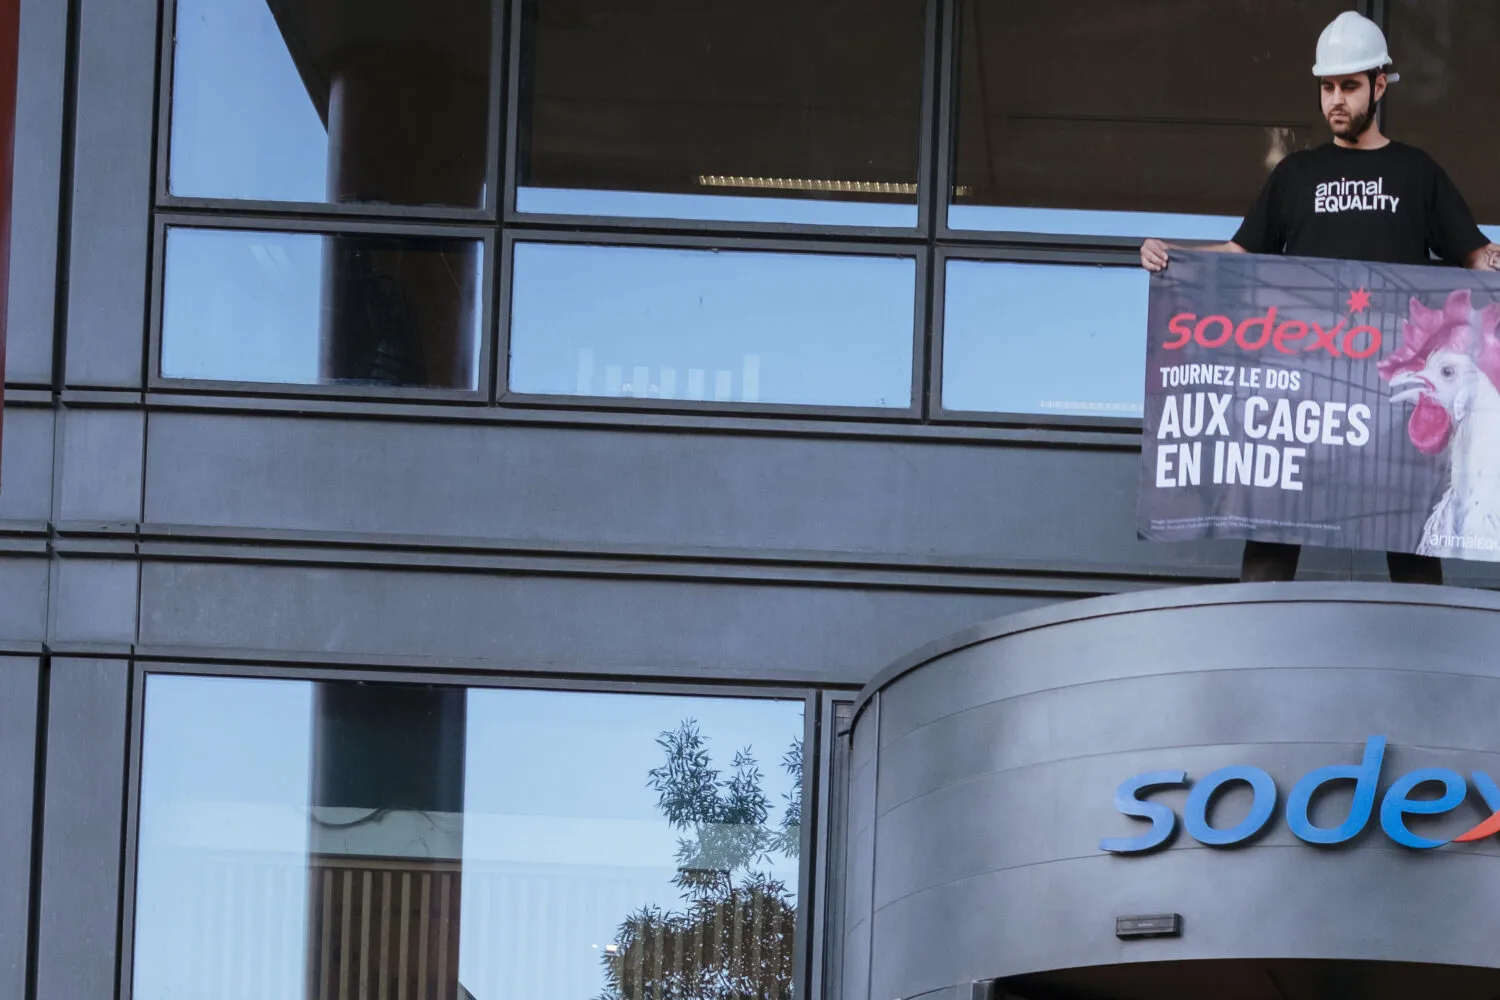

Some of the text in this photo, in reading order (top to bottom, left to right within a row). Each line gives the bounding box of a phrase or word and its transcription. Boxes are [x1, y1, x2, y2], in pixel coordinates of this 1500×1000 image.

[1314, 194, 1400, 213] EQUALITY
[1315, 176, 1383, 197] animal
[1161, 306, 1382, 359] sodexo
[1159, 363, 1301, 391] TOURNEZ LE DOS
[1156, 392, 1371, 447] AUX CAGES
[1155, 440, 1306, 491] EN INDE
